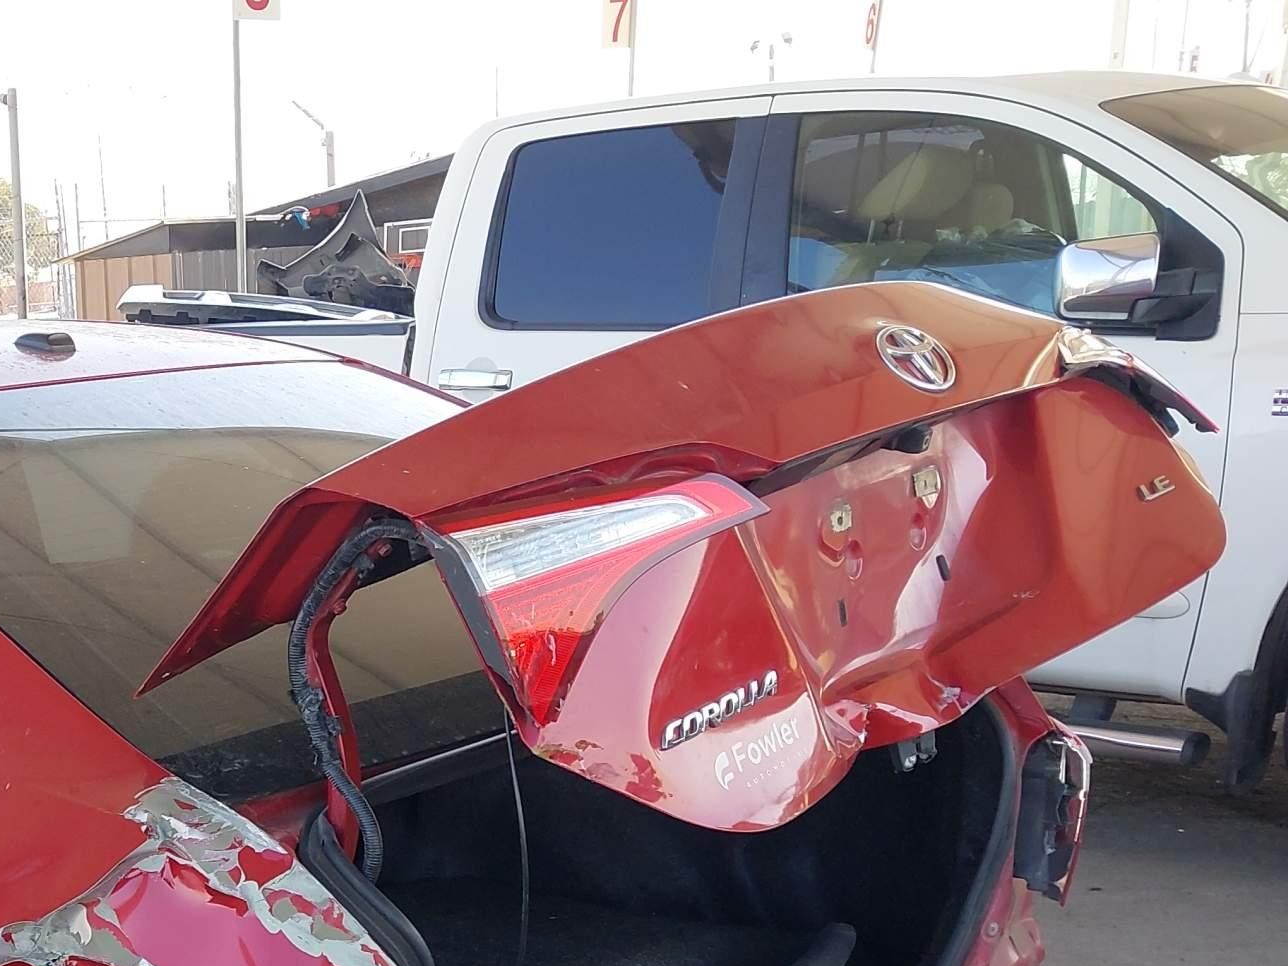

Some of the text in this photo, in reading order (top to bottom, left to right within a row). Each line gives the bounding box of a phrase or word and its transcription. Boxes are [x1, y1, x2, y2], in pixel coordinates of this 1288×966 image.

[609, 0, 628, 42] 7
[865, 2, 876, 45] 6
[1137, 474, 1176, 501] LE
[660, 670, 778, 750] COROLLA
[732, 716, 800, 773] Fowler
